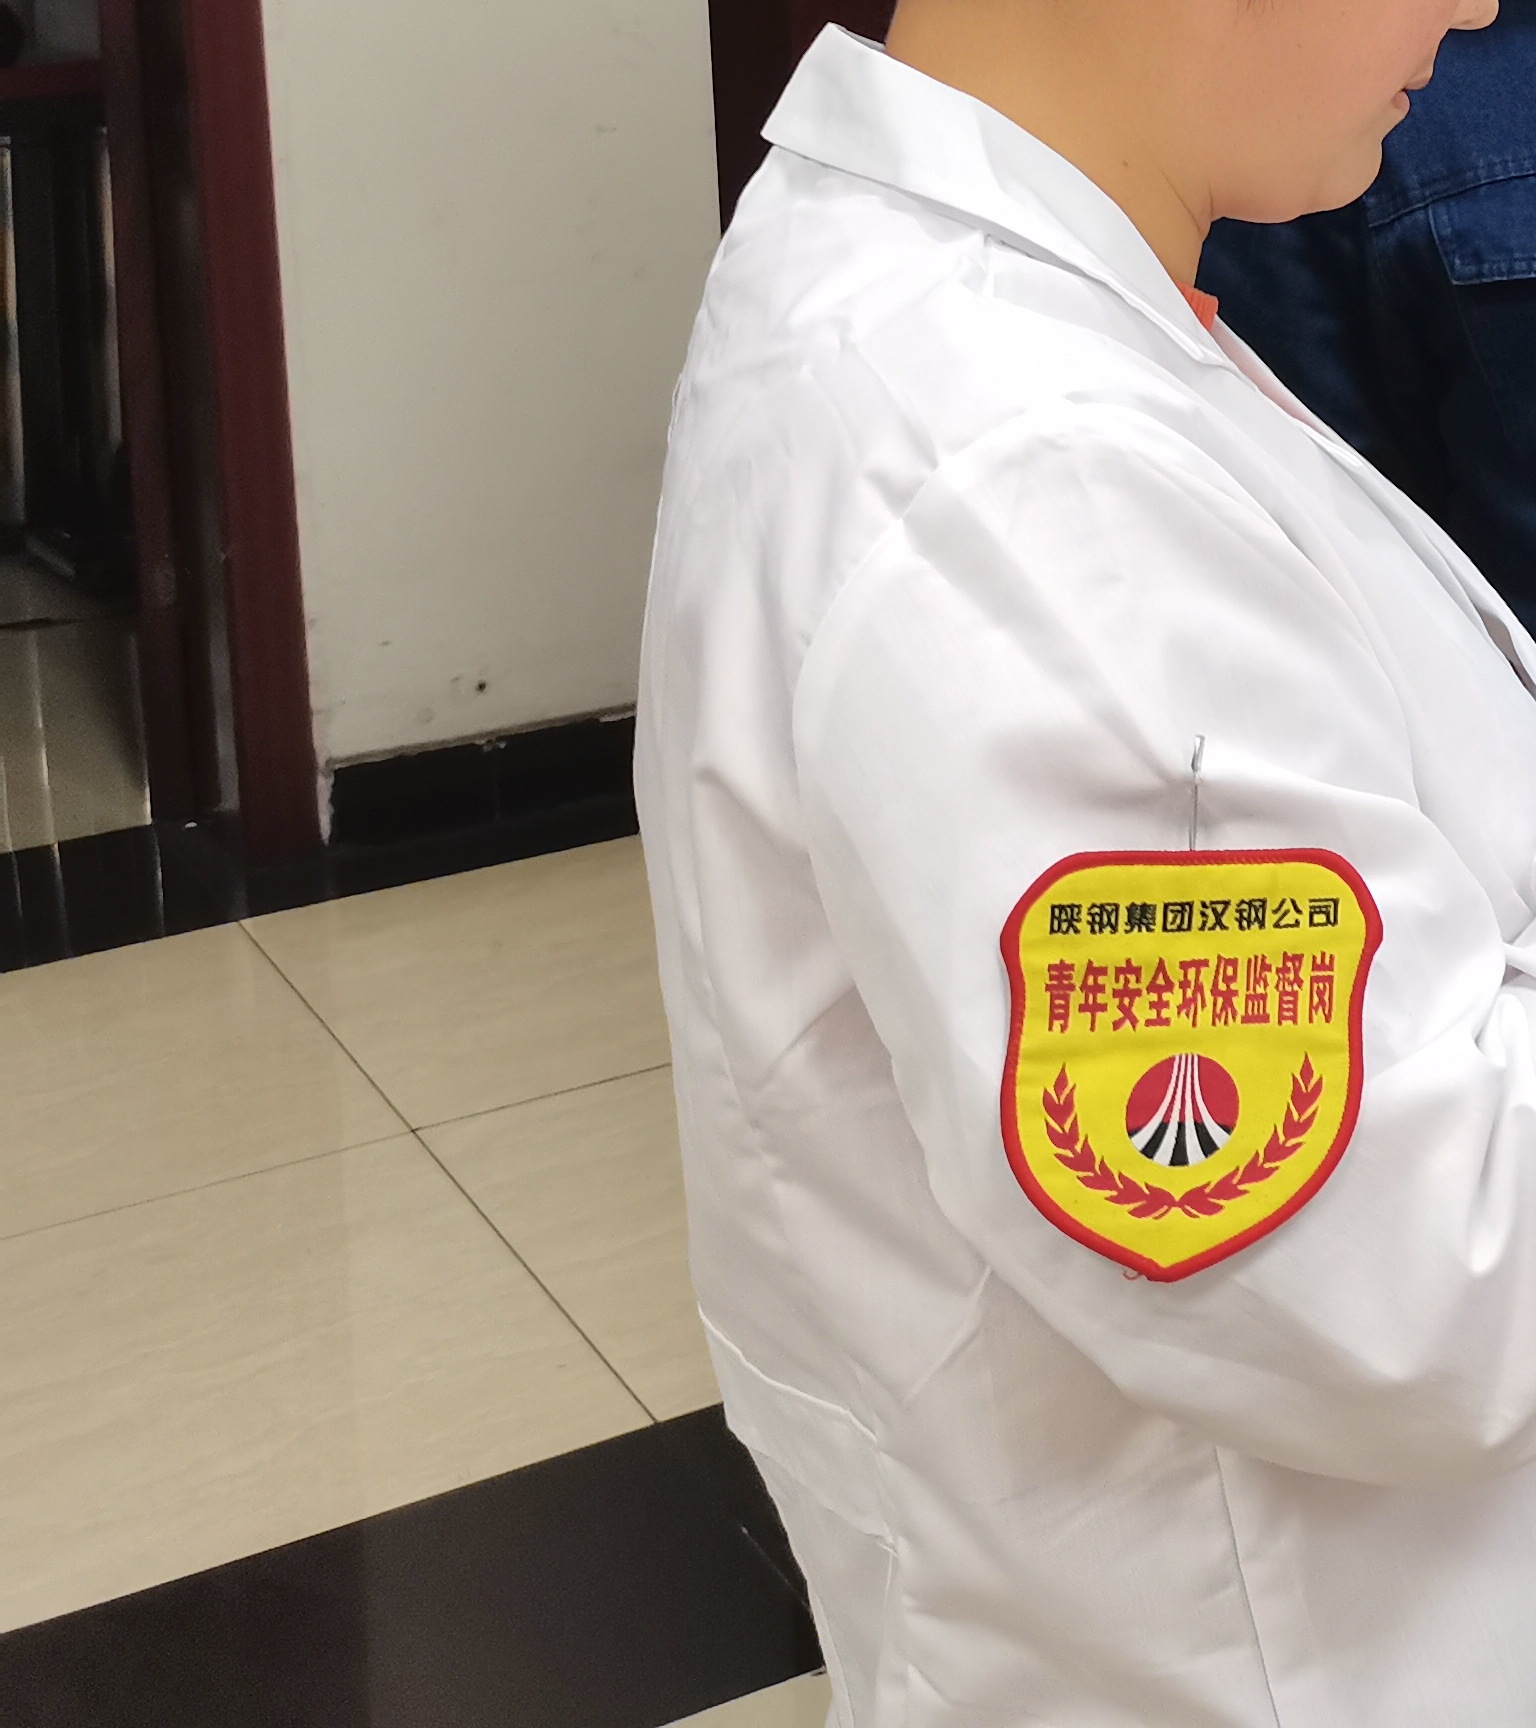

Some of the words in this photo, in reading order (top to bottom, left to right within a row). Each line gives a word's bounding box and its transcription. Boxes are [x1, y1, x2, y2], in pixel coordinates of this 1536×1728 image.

[1049, 897, 1340, 936] 陕钢集团汉钢公司
[1045, 951, 1336, 1033] 青年安全环保监督岗
